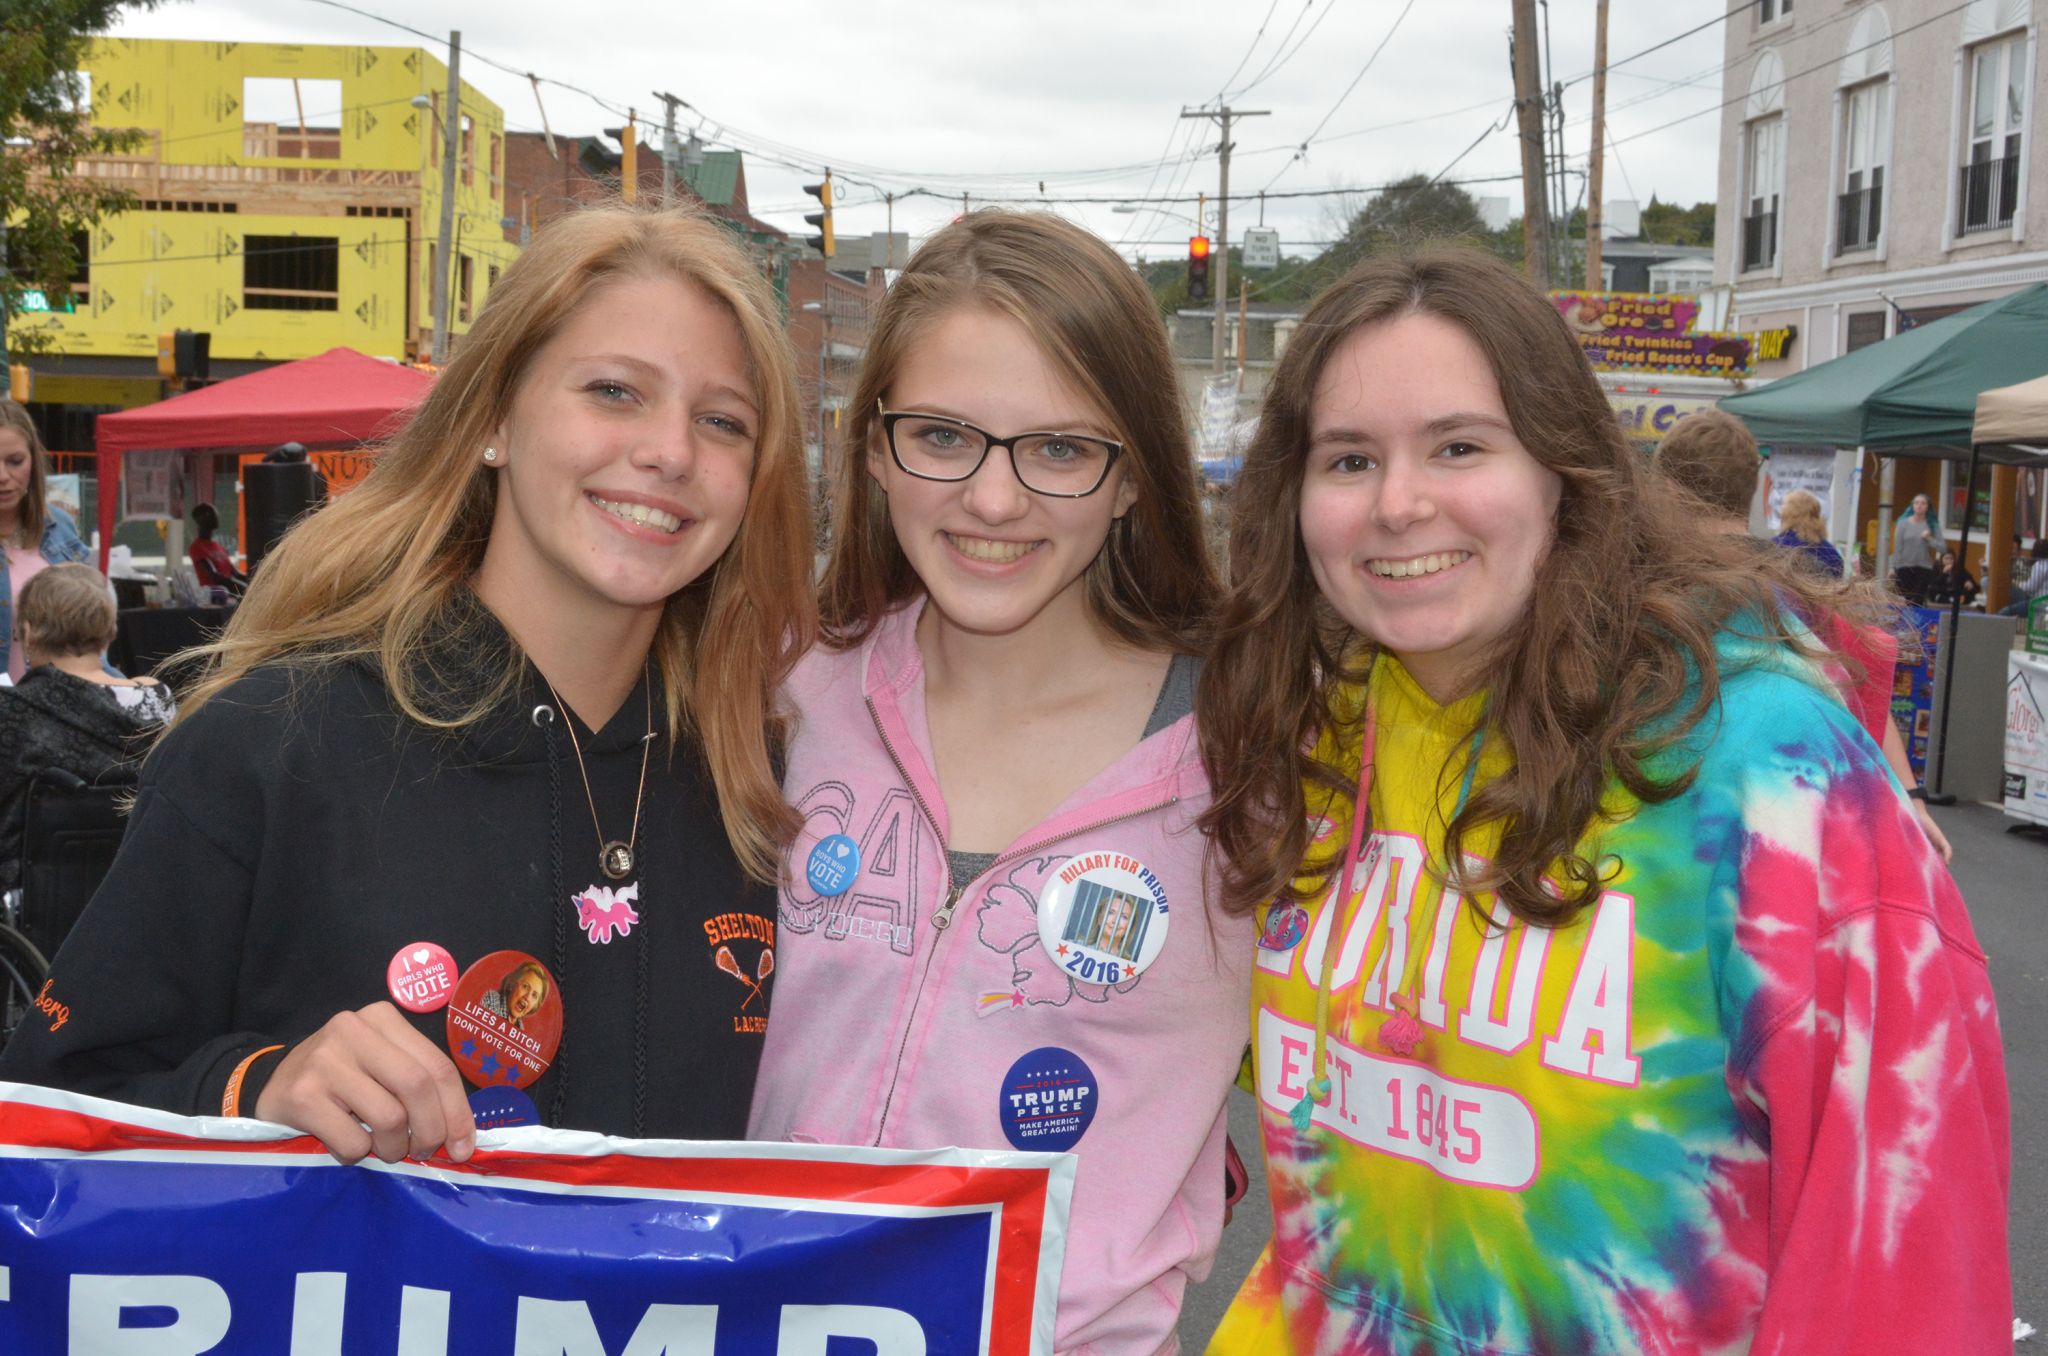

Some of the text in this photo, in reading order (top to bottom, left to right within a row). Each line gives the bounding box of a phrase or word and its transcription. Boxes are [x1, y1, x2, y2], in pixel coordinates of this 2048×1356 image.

[1607, 301, 1671, 315] Fried
[1624, 335, 1692, 349] Twinkies
[1605, 349, 1734, 367] Fried Reese's Cup
[809, 857, 842, 888] VOTE
[815, 849, 847, 873] BOYS WHO
[1060, 854, 1169, 914] HILLARY FOR PRISON
[703, 912, 774, 948] SHELTON
[828, 912, 912, 948] DIEGO
[397, 962, 445, 986] GIRLS WHO
[402, 957, 412, 973] I
[1065, 950, 1120, 984] 2016
[401, 971, 451, 1002] VOTE
[465, 1001, 541, 1053] LIFES A BITCH
[453, 1015, 541, 1073] DONT VOTE FOR ONE
[1036, 1079, 1061, 1089] 2016
[1009, 1086, 1090, 1108] TRUMP
[1017, 1102, 1082, 1118] PENCE
[1386, 1077, 1482, 1165] 1845
[1019, 1116, 1080, 1130] MAKE AMERICA
[1021, 1125, 1078, 1137] GREAT AGAIN!
